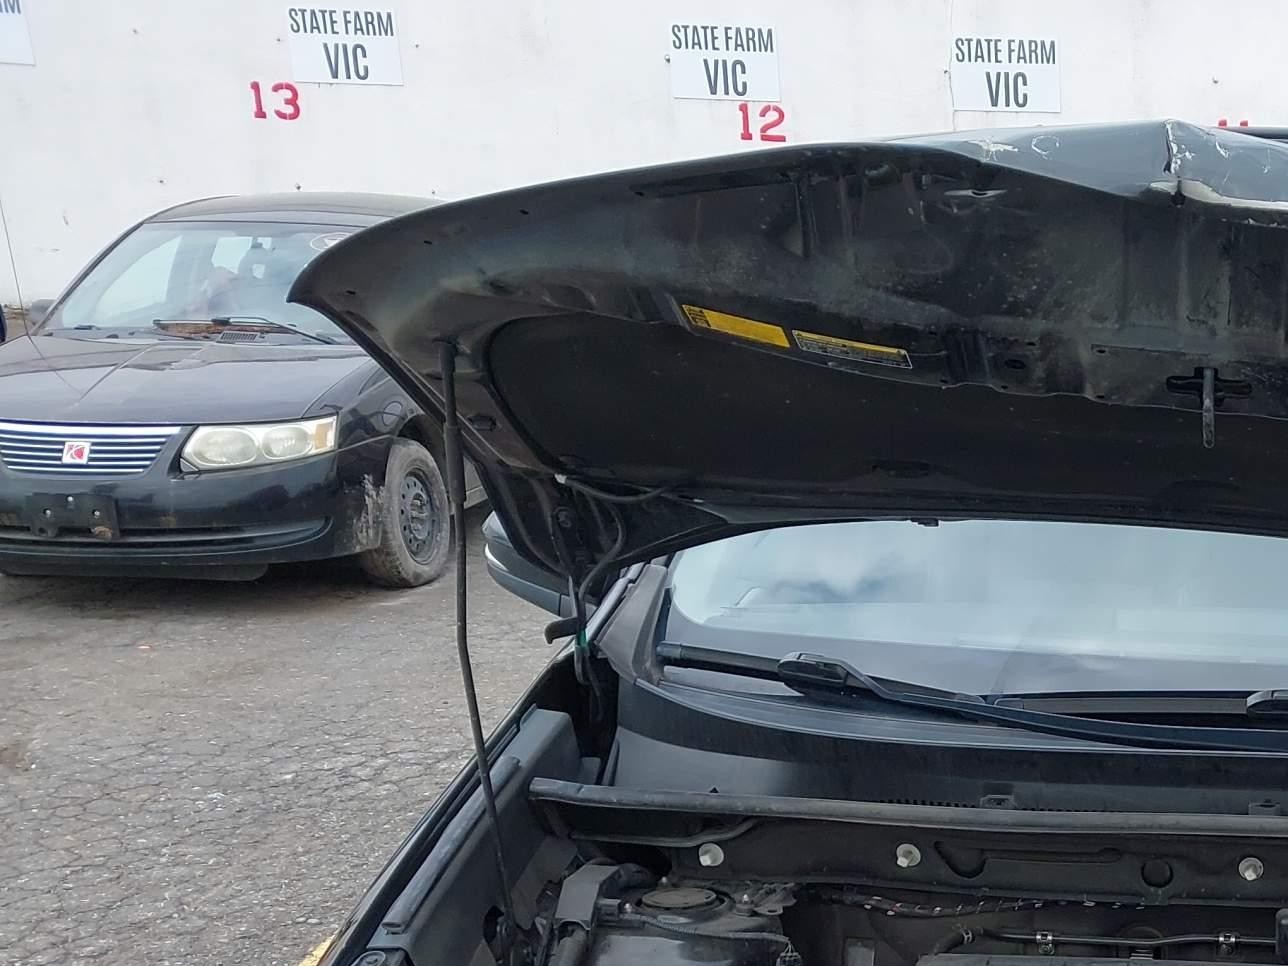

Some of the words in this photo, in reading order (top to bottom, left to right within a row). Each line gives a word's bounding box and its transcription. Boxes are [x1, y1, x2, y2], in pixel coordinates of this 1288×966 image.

[288, 8, 340, 35] STATE
[342, 10, 395, 37] FARM
[671, 24, 720, 51] STATE
[724, 26, 774, 53] FARM
[322, 42, 370, 81] VIC
[955, 37, 1003, 64] STATE
[1007, 39, 1056, 65] FARM
[702, 58, 748, 97] VIC
[985, 71, 1028, 108] VIC
[249, 80, 301, 121] 13
[738, 102, 787, 143] 12
